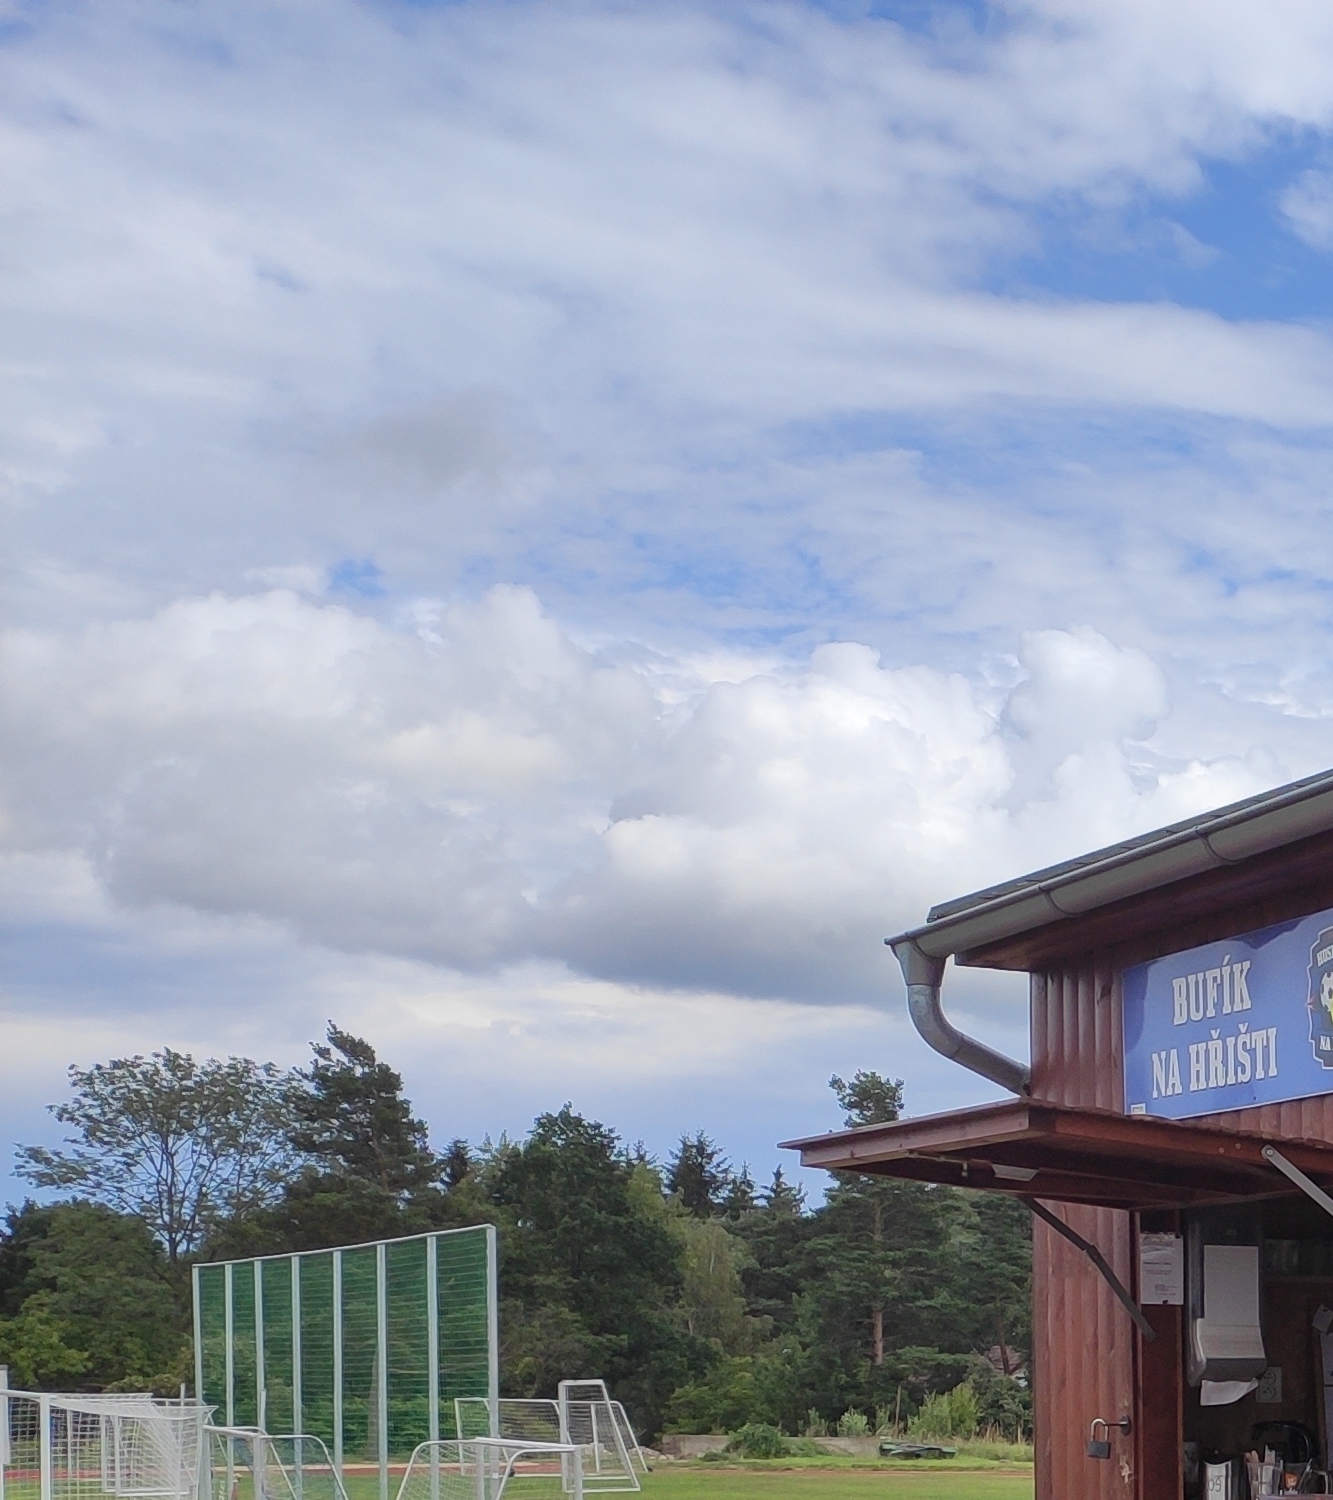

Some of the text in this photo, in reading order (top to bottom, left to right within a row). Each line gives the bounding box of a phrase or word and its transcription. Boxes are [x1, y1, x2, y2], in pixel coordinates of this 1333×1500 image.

[1172, 955, 1252, 1026] BUFÍK
[1152, 1023, 1278, 1098] NA HŘIŠTI
